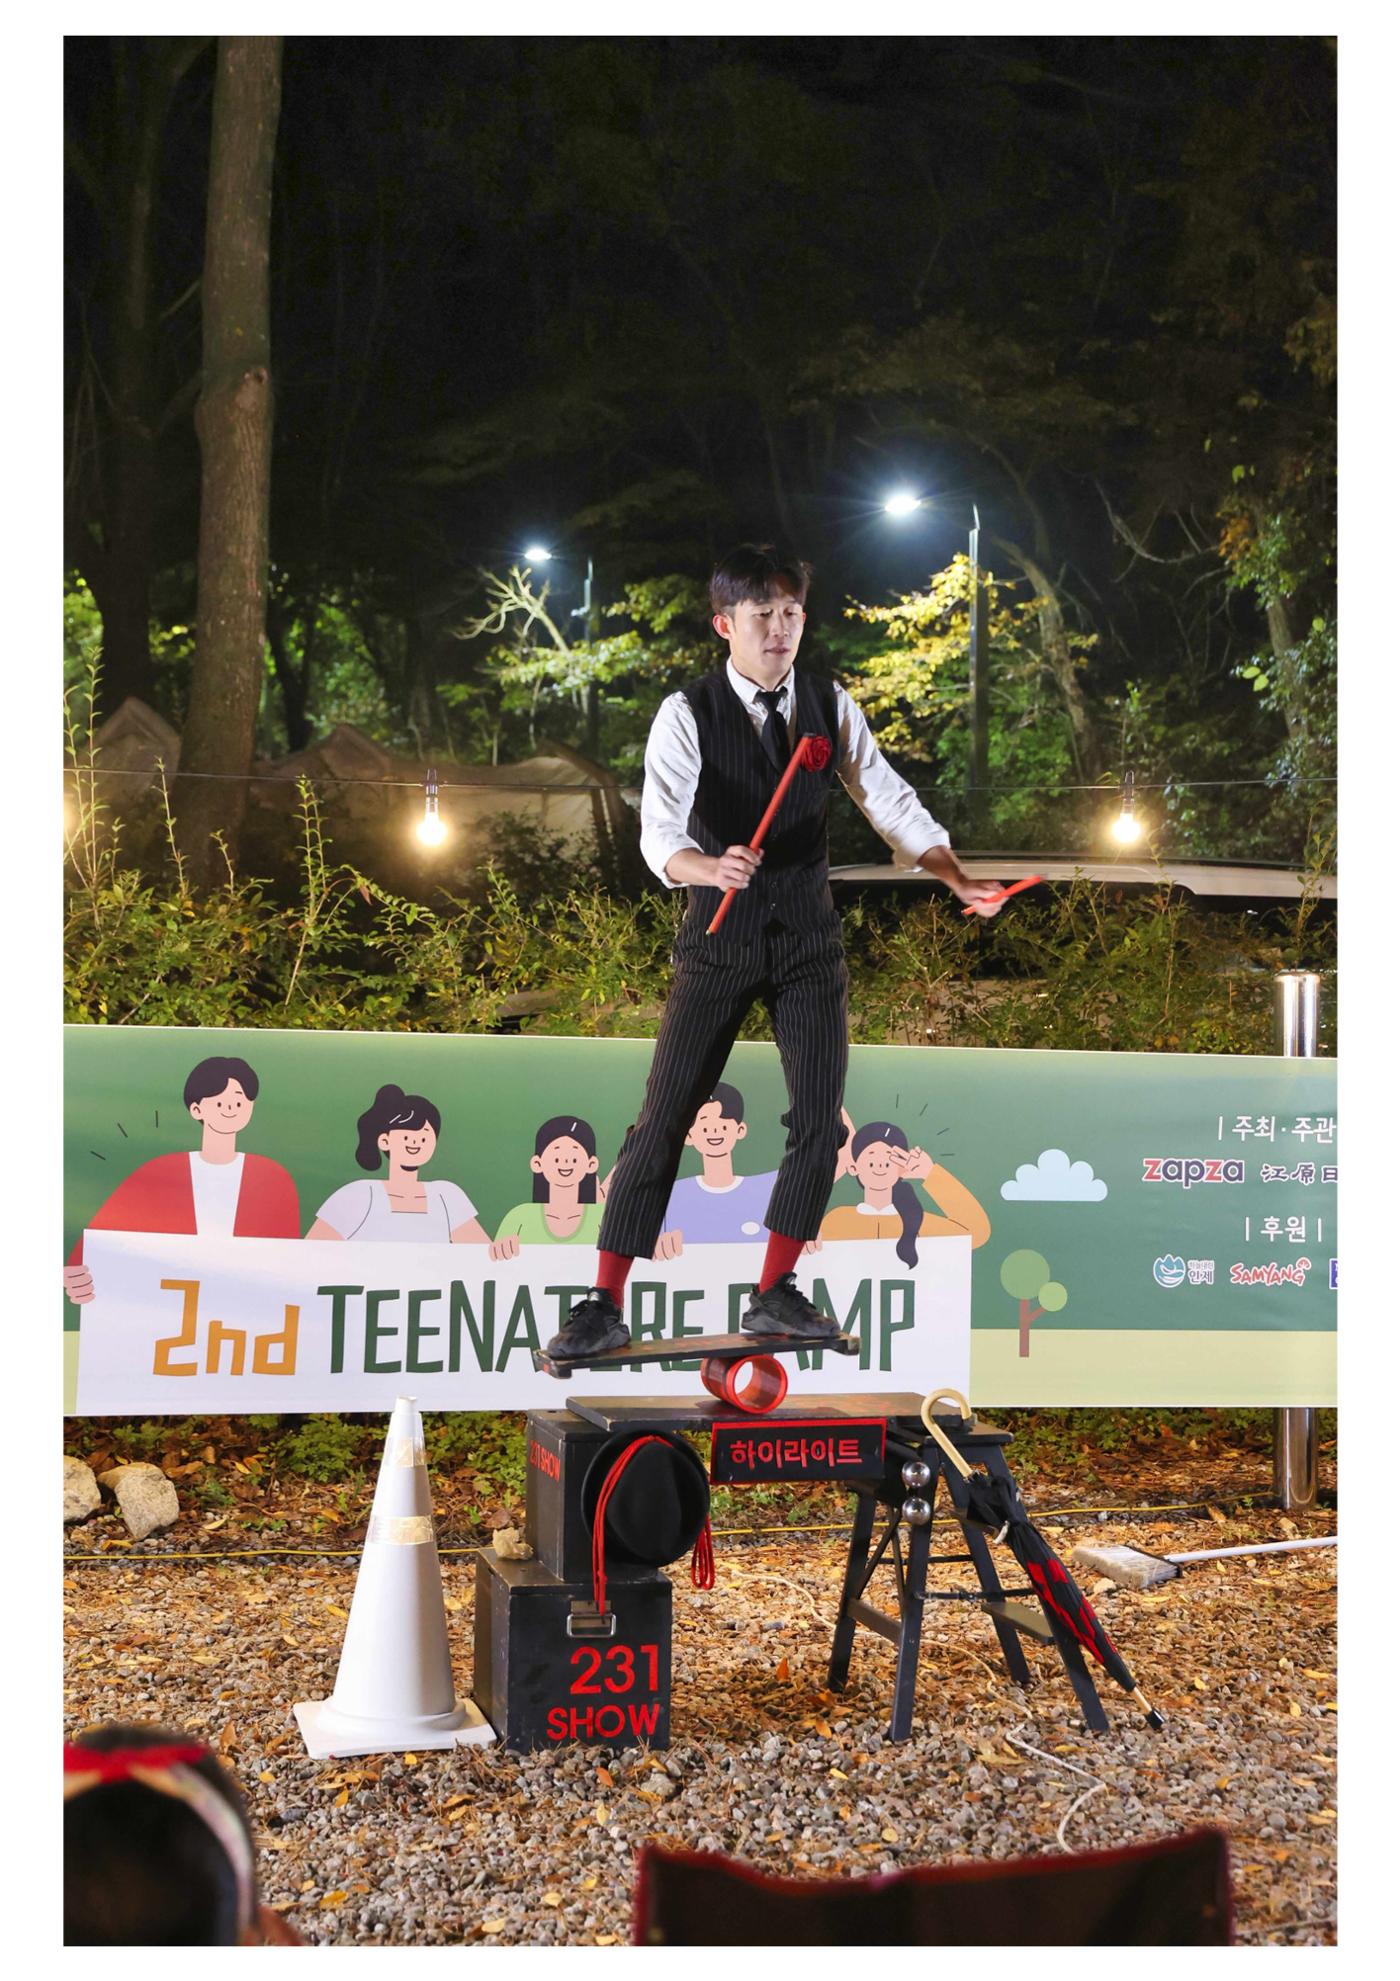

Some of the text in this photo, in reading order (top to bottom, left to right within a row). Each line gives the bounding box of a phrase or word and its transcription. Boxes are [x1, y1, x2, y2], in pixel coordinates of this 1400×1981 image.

[1143, 1158, 1245, 1188] zapza
[1260, 1216, 1306, 1243] 후원
[1230, 1258, 1311, 1286] SAMYANG
[153, 1278, 915, 1376] 2nd TEENATRE CMP
[730, 1438, 863, 1469] 하이라이트
[569, 1643, 660, 1695] 231
[546, 1703, 661, 1741] SHOW
